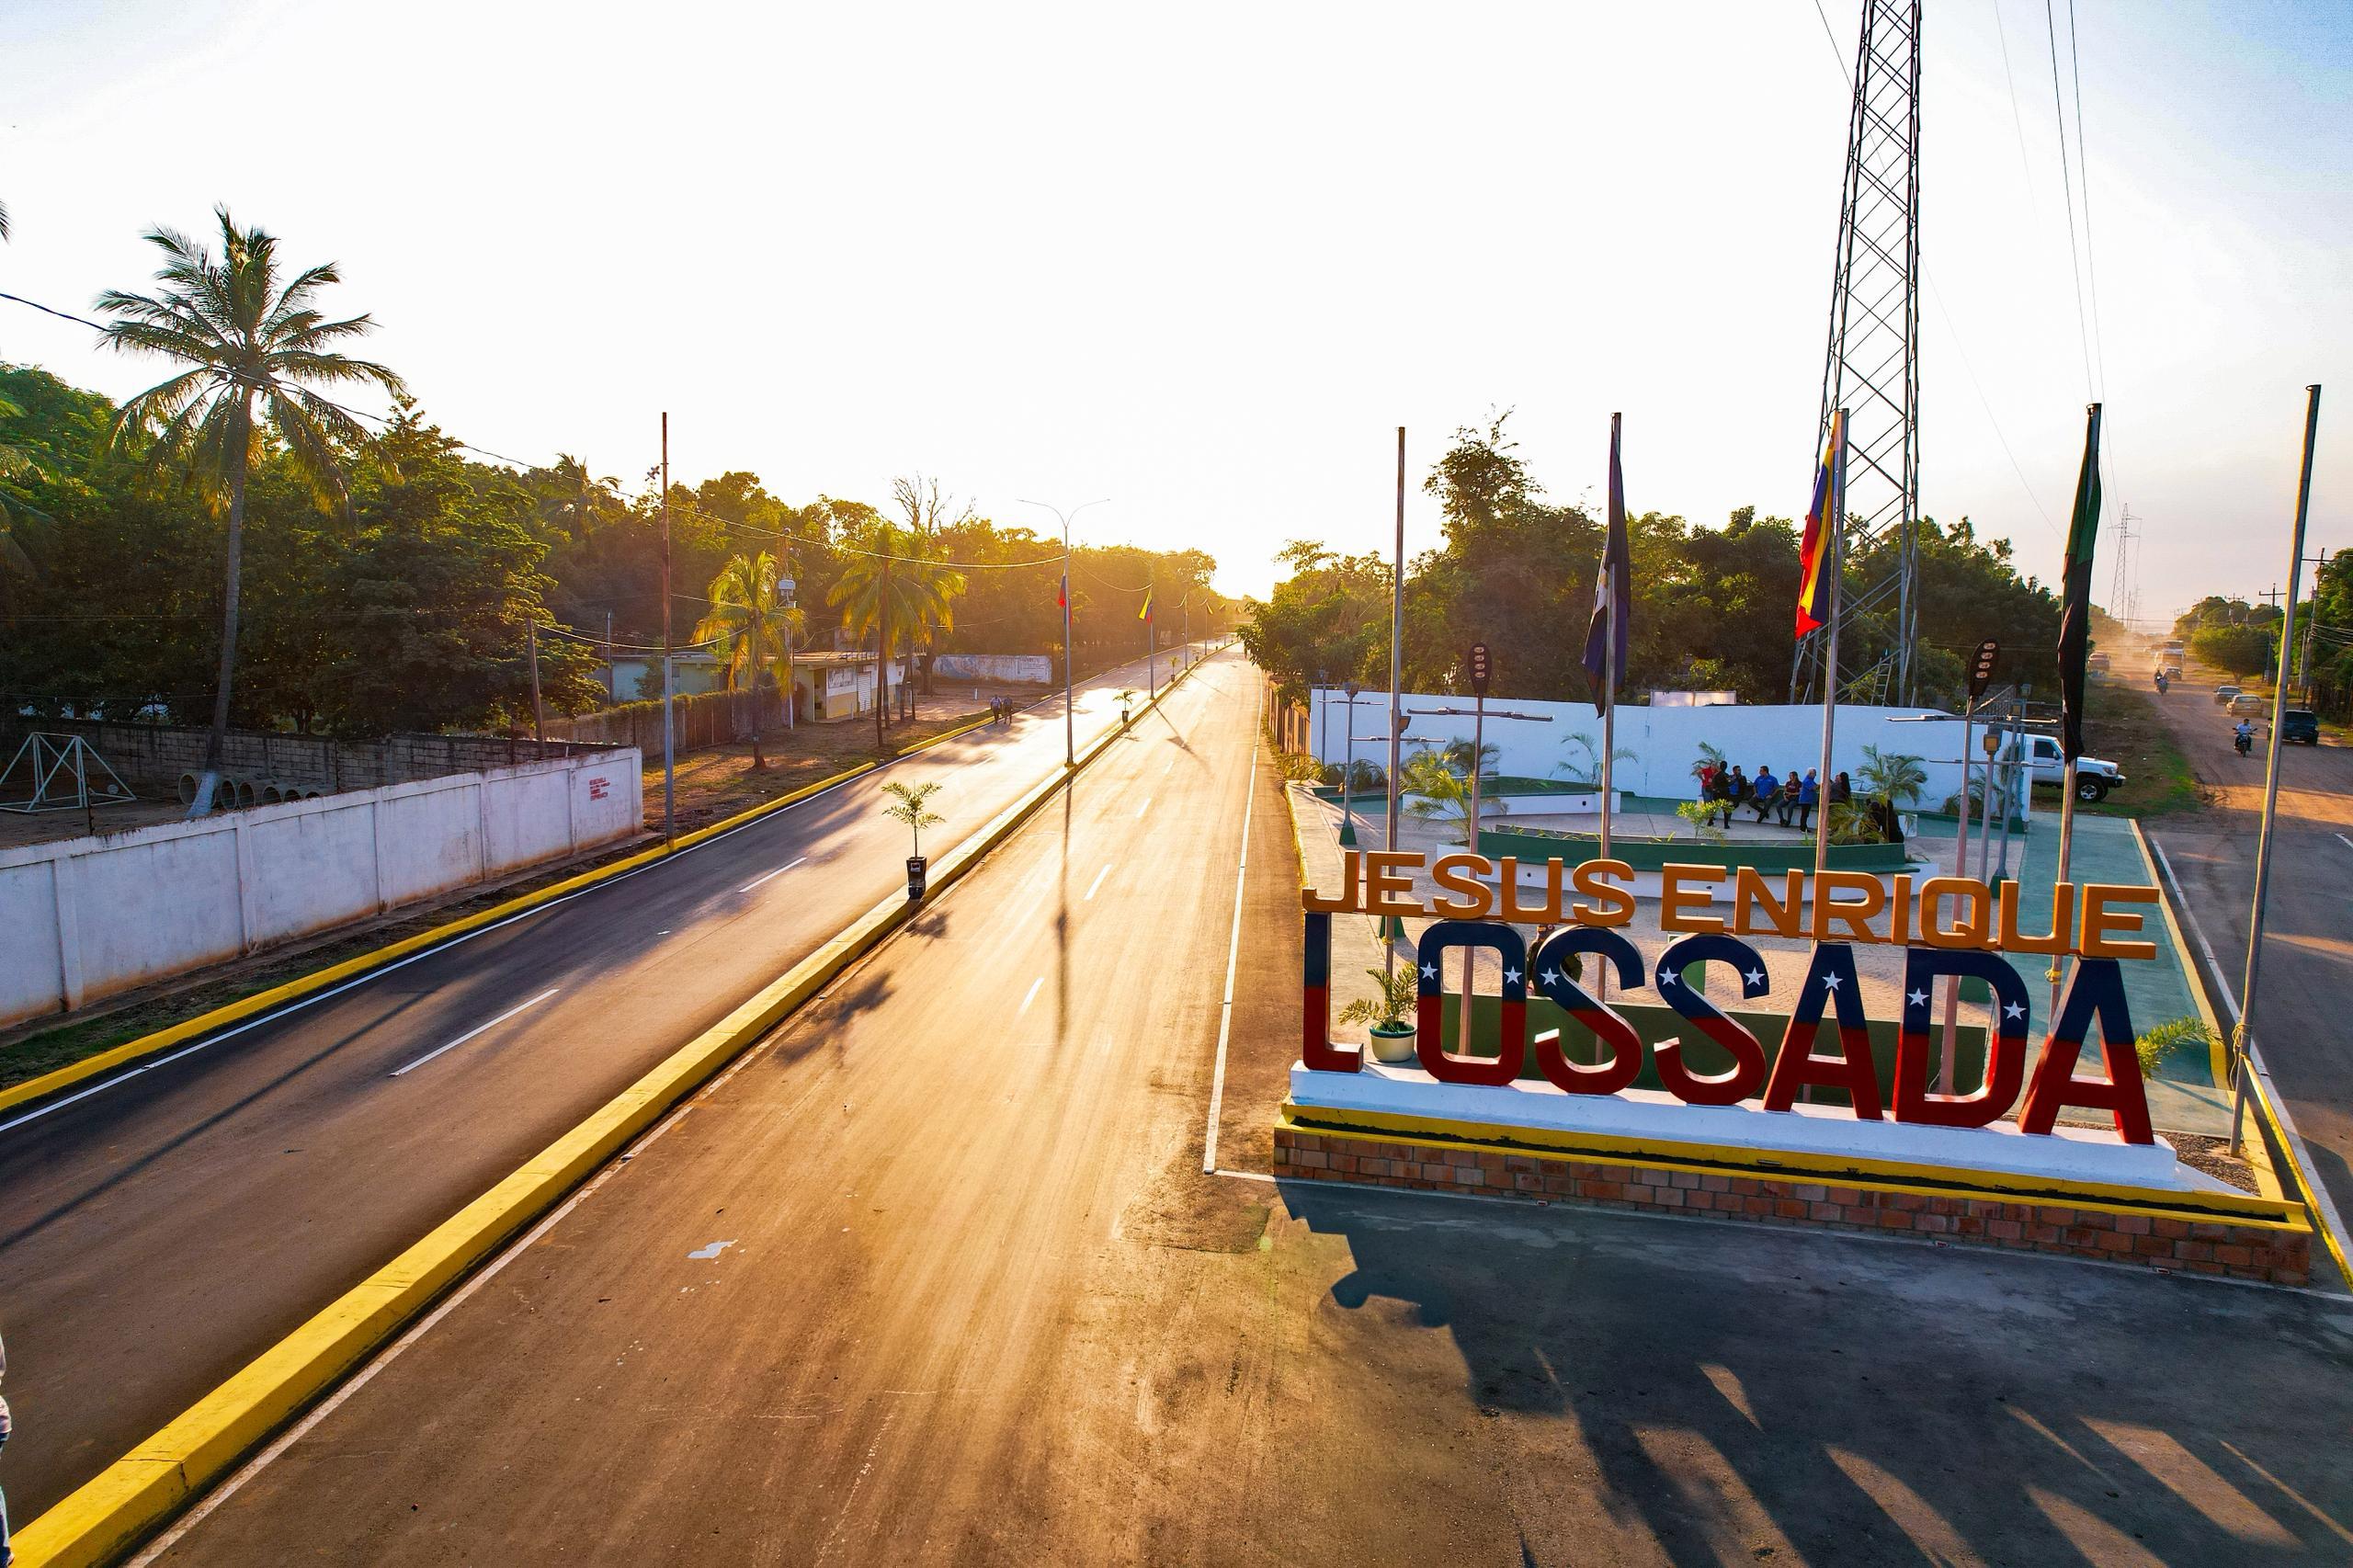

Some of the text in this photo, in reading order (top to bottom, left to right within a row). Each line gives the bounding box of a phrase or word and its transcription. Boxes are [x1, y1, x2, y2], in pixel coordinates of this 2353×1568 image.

[1302, 850, 2160, 960] JESUS ENRIQUE
[1302, 913, 2155, 1145] LOSSADA
